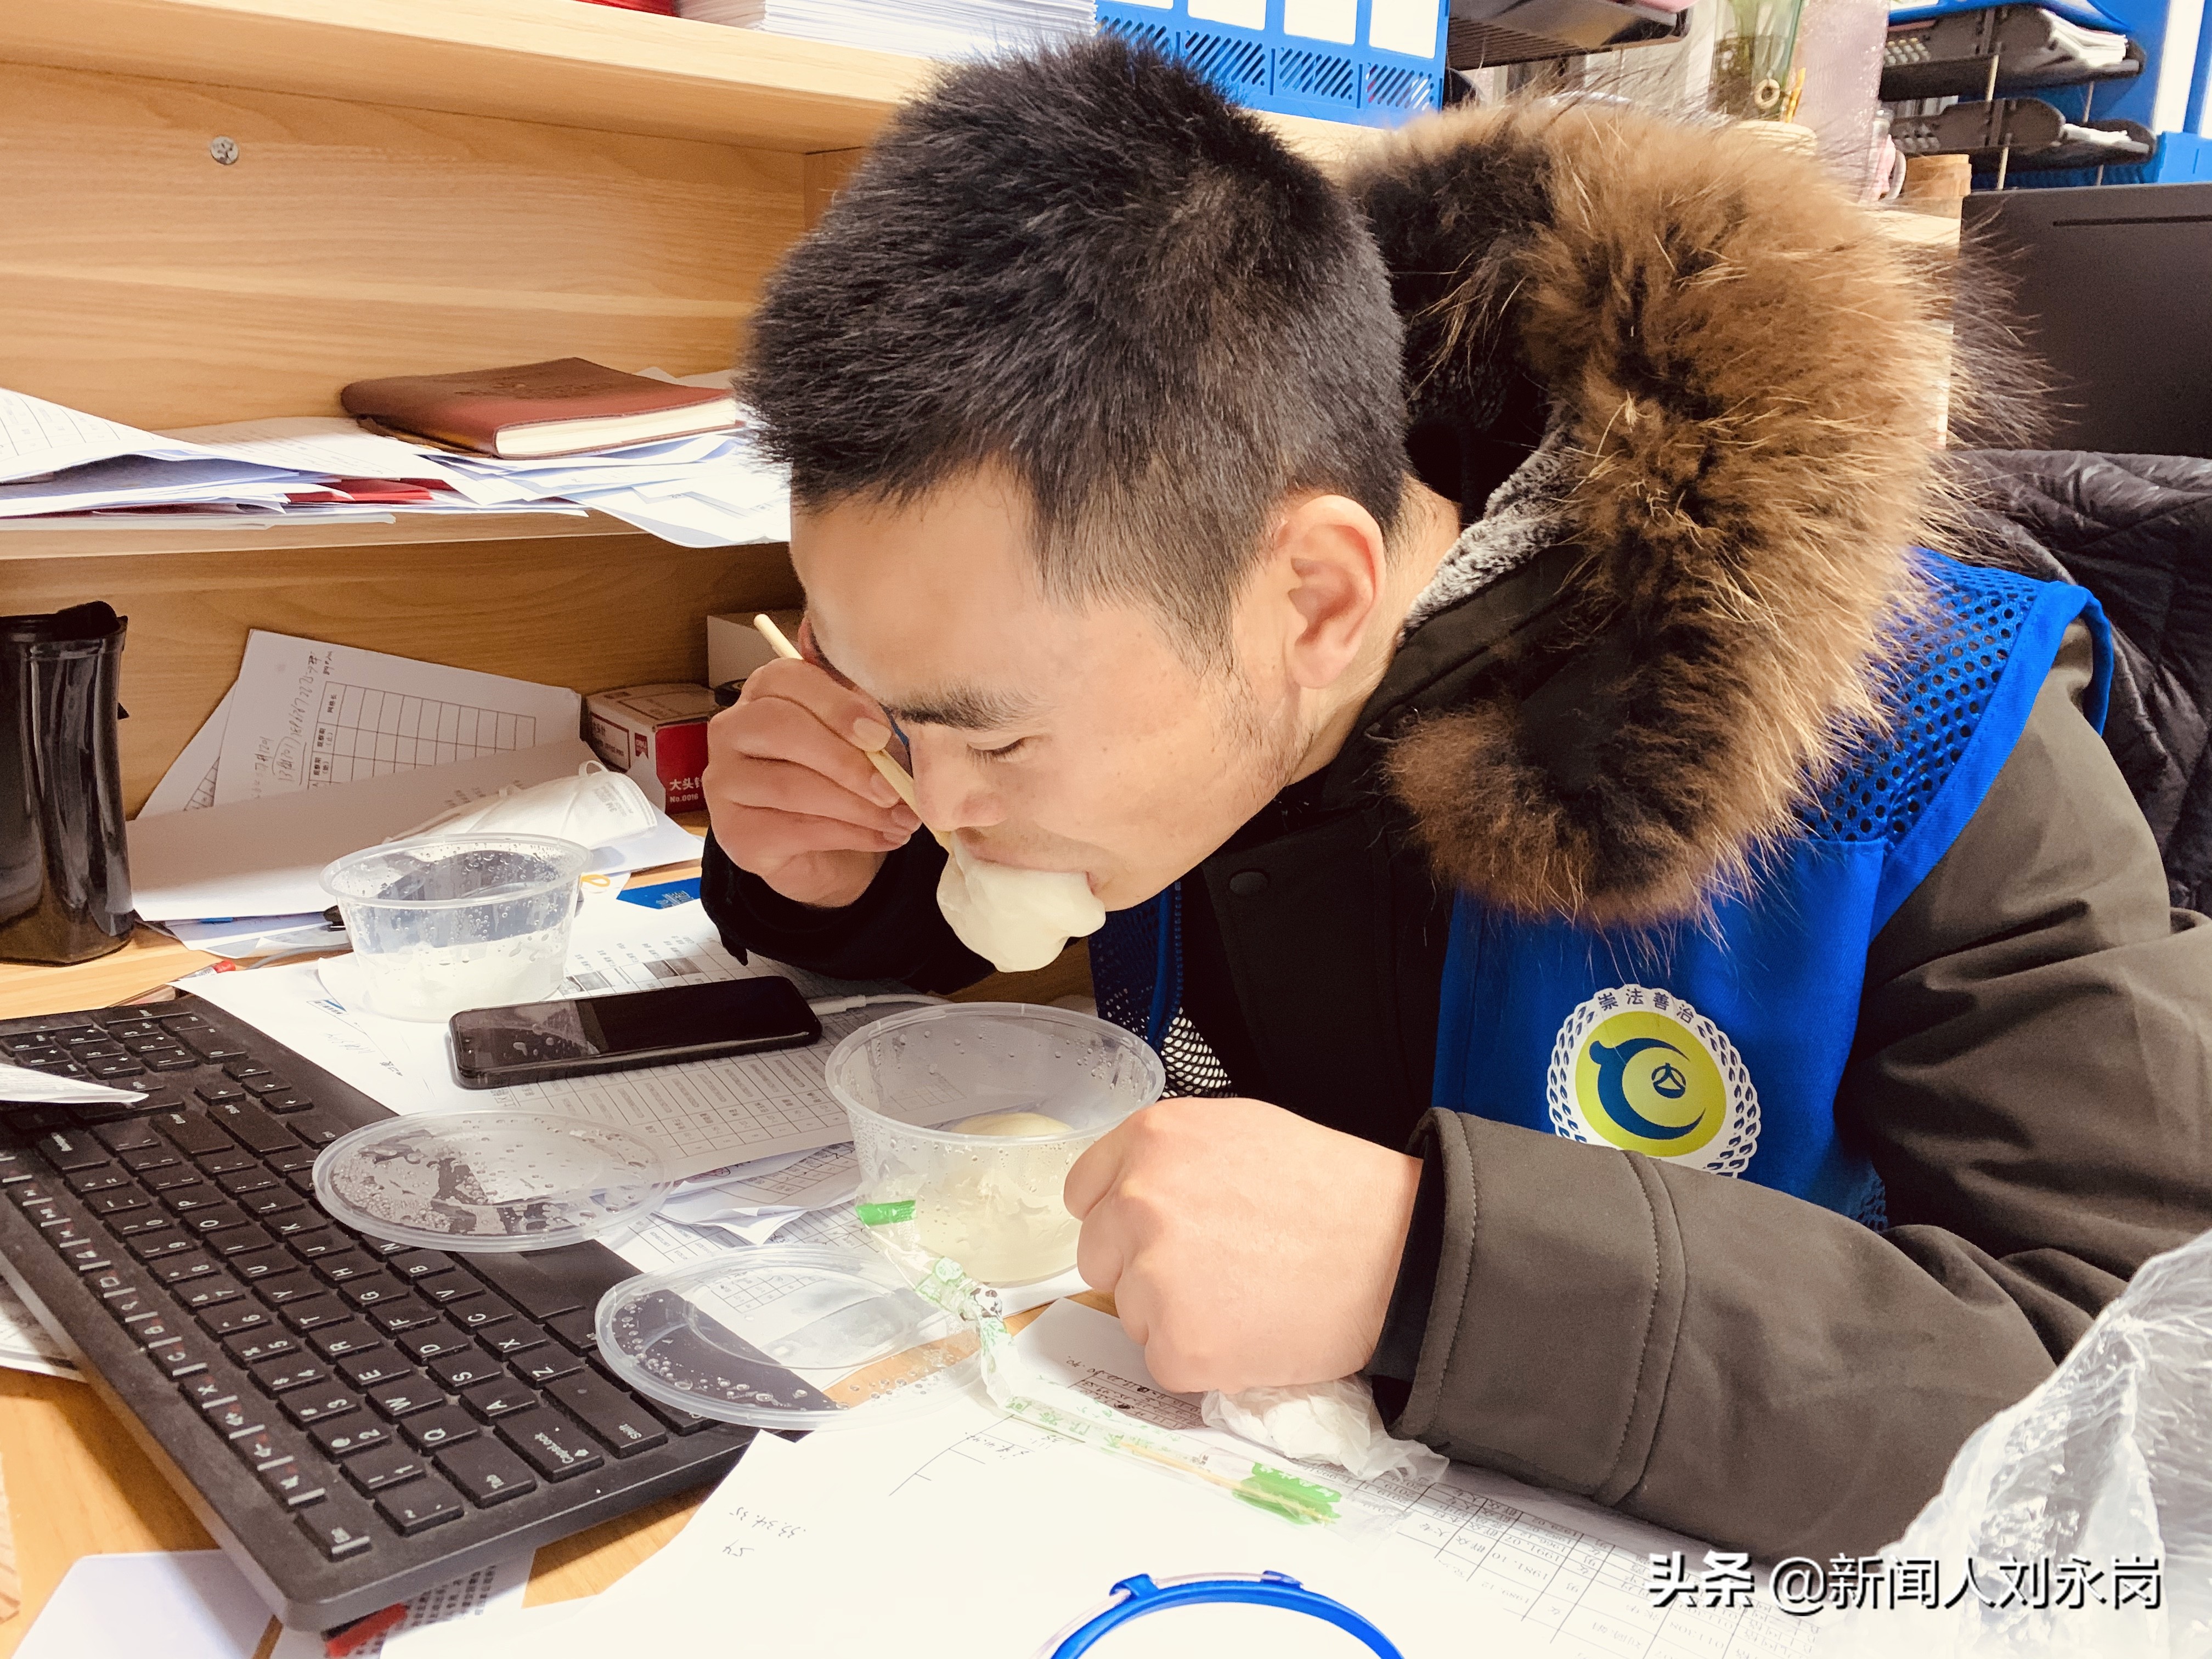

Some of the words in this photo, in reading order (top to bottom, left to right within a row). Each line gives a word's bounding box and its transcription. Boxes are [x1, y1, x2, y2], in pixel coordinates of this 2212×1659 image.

[1598, 988, 1695, 1023] 崇法善治
[280, 1223, 301, 1231] K
[380, 1243, 400, 1251] N
[247, 1265, 268, 1273] U
[332, 1267, 353, 1277] H
[409, 1265, 428, 1273] B
[273, 1290, 293, 1299] Y
[360, 1291, 380, 1301] G
[436, 1290, 455, 1298] V
[300, 1316, 320, 1324] T
[389, 1318, 410, 1327] F
[467, 1313, 487, 1322] C
[329, 1340, 351, 1352] R
[498, 1338, 521, 1349] X
[419, 1344, 441, 1354] D
[358, 1369, 382, 1381] E
[452, 1371, 472, 1382] S
[532, 1366, 555, 1378] Z
[385, 1397, 411, 1412] W
[486, 1400, 508, 1410] A
[424, 1427, 446, 1442] Q
[618, 1423, 642, 1440] Shift
[534, 1432, 574, 1464] CapsLock
[1503, 1536, 1561, 1562] 1991.07
[1489, 1551, 1549, 1579] 1981.10
